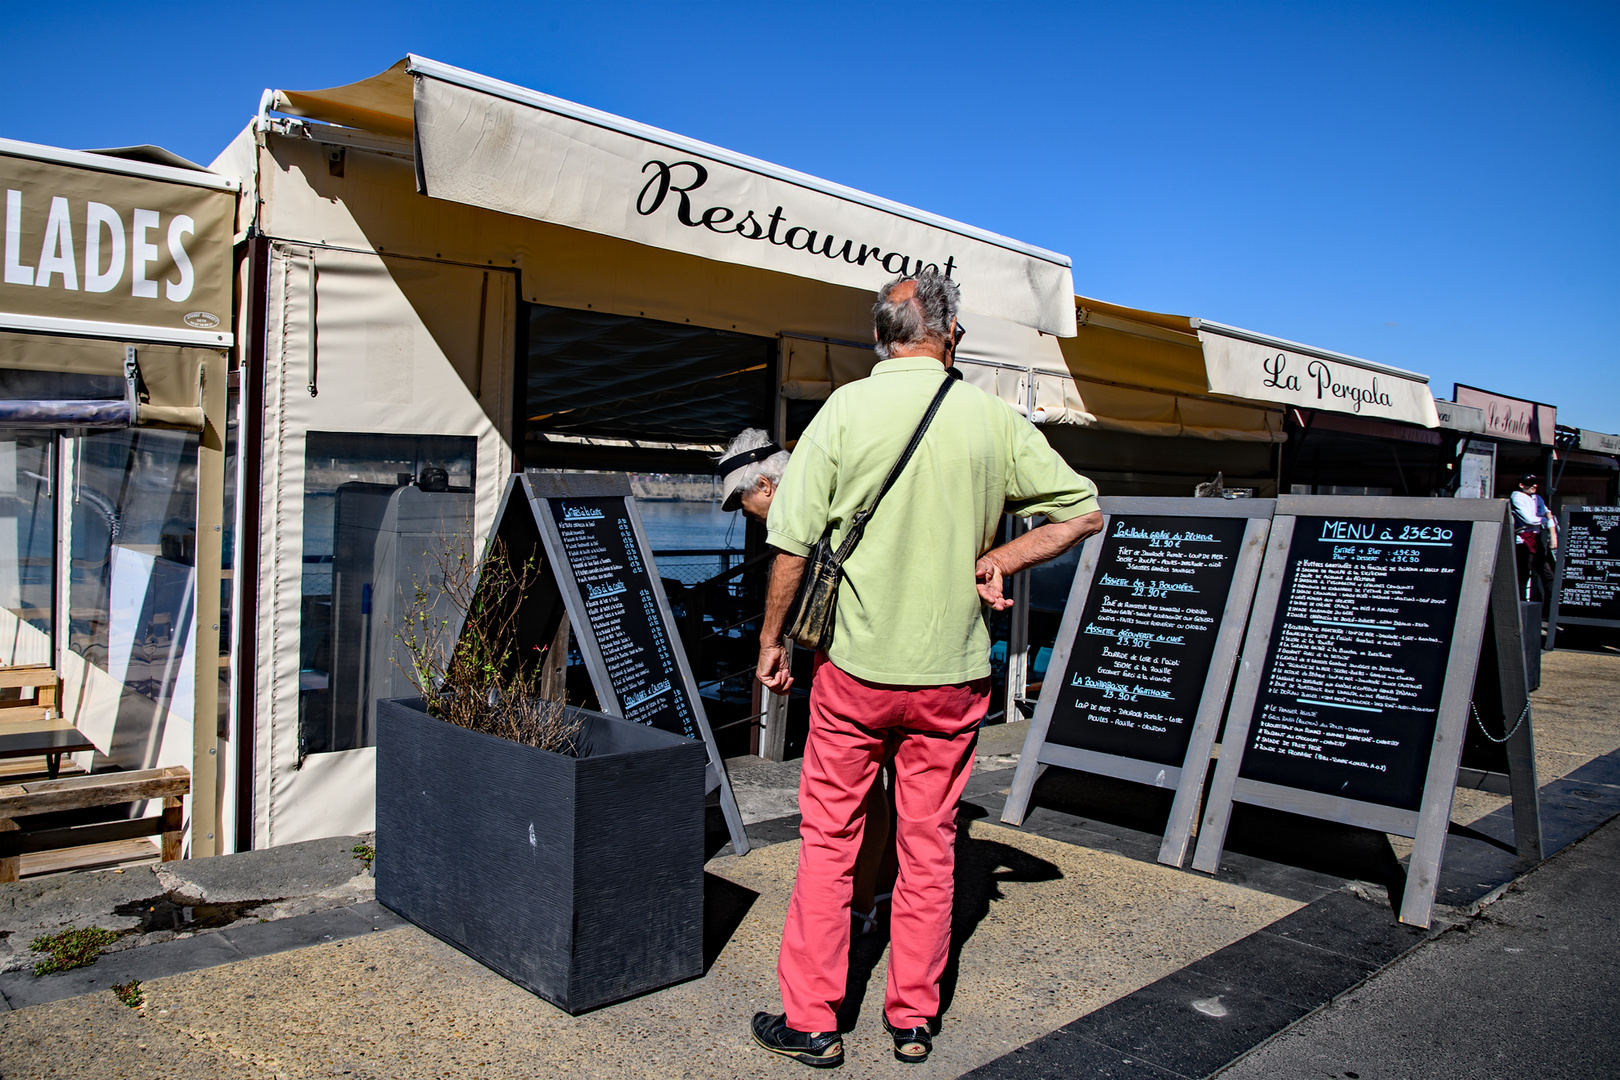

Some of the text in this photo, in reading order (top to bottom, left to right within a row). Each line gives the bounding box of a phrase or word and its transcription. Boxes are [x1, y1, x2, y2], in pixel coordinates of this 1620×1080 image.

[4, 189, 195, 302] LADES
[636, 160, 961, 289] Restaurant
[1263, 353, 1393, 413] La Pergola
[1487, 401, 1500, 430] Le
[1322, 521, 1453, 540] MENU à 23€90
